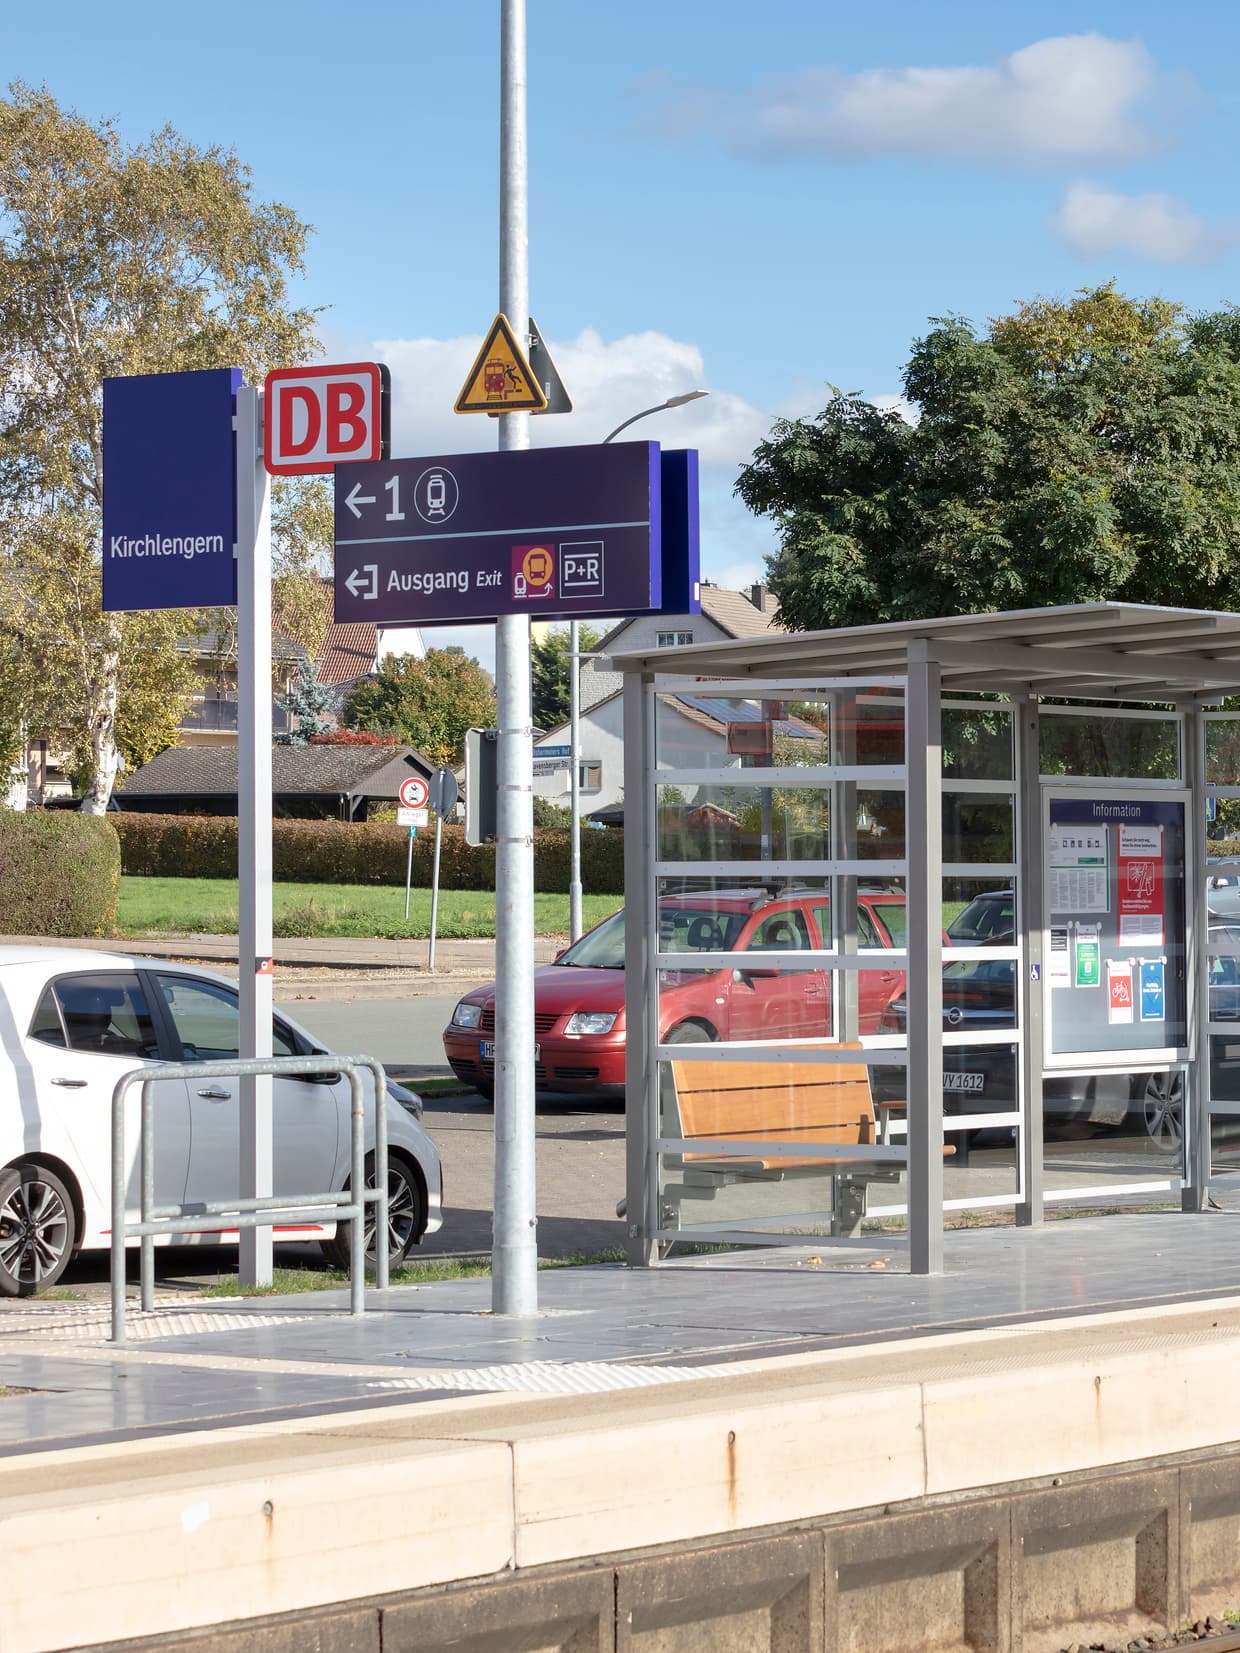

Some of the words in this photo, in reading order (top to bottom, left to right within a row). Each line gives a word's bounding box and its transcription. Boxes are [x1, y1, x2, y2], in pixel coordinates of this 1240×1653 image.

[279, 381, 368, 458] DB
[384, 475, 405, 521] 1
[111, 533, 224, 559] Kirchlengern
[387, 567, 469, 595] Ausgang
[476, 569, 502, 588] Exit
[564, 558, 599, 581] P+R
[1092, 802, 1141, 817] Information
[956, 1074, 983, 1089] 1612
